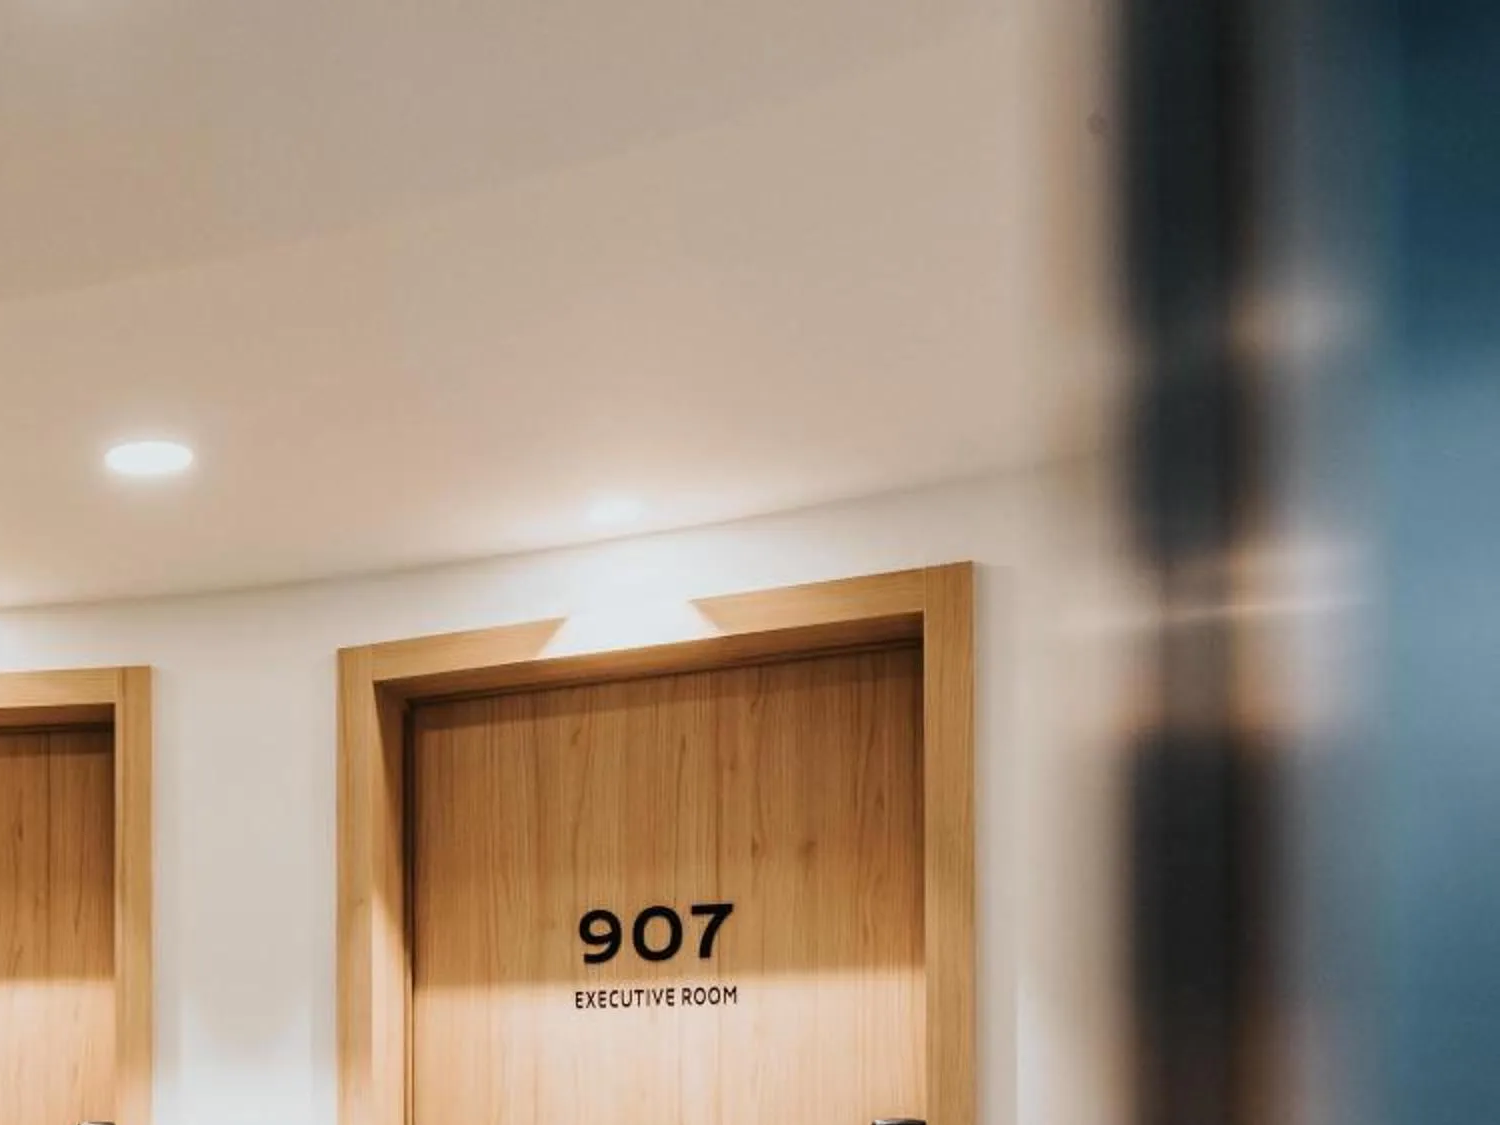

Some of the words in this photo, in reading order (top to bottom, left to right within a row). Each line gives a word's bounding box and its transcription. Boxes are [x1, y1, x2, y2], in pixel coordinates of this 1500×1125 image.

[578, 903, 734, 964] 907
[575, 988, 675, 1009] EXECUTIVE
[681, 986, 737, 1005] ROOM
